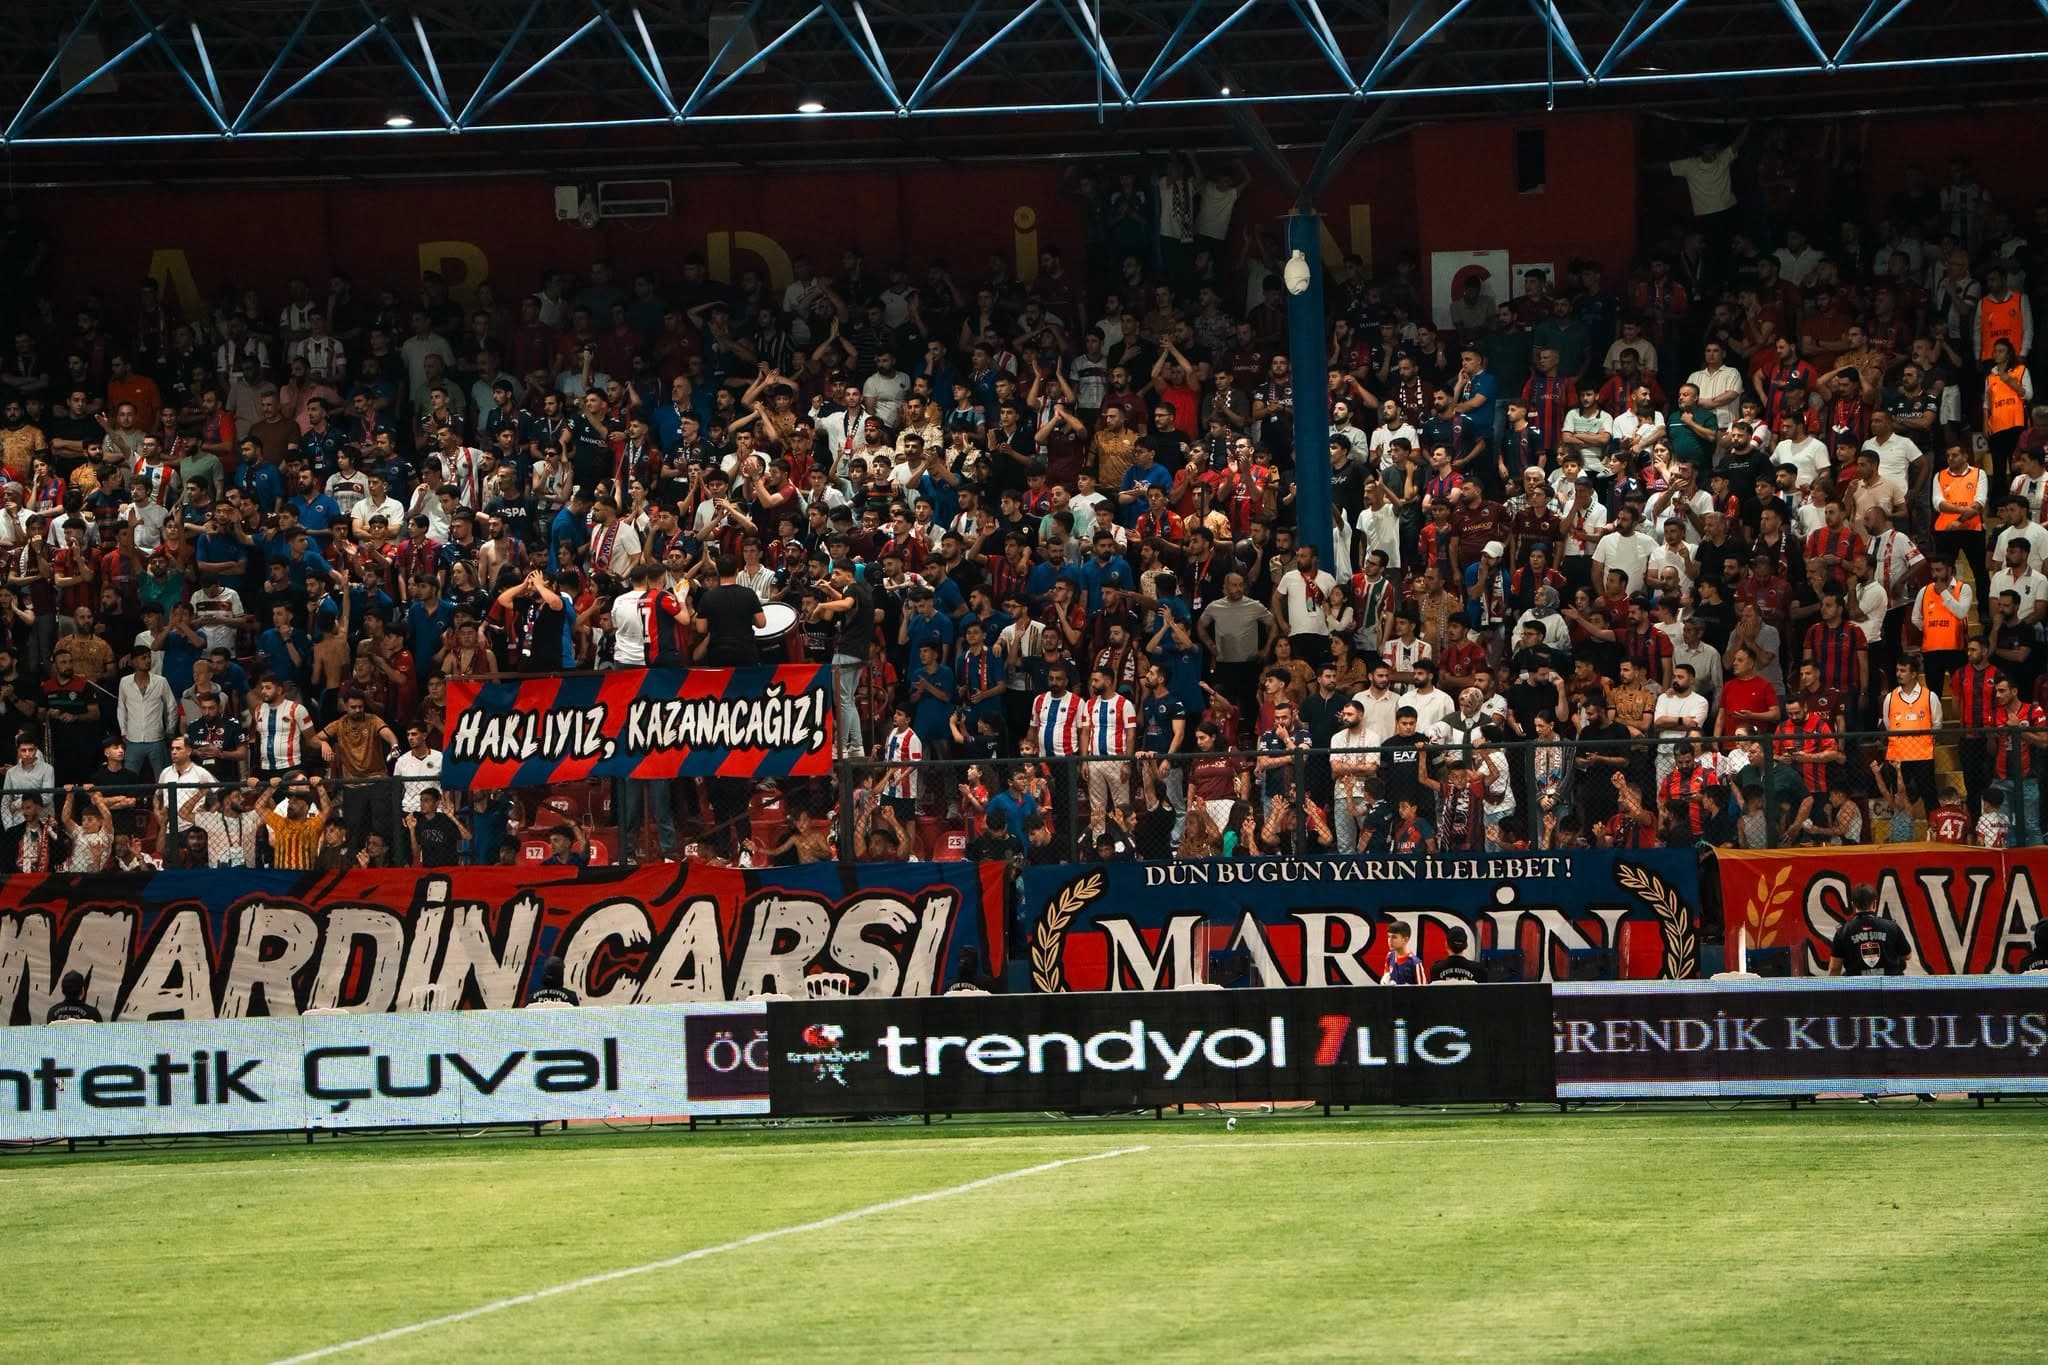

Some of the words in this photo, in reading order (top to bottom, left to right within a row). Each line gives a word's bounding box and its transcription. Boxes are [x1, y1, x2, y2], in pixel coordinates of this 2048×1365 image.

[497, 507, 527, 518] SPA
[454, 705, 616, 759] HAKLIYIZ,
[628, 685, 825, 753] KAZANACAĞIZ!
[1393, 751, 1418, 761] EA7
[1939, 818, 1965, 840] 47
[1144, 858, 1210, 886] DÜN
[1217, 857, 1324, 883] BUGÜN
[1328, 859, 1418, 882] YARIN
[0, 880, 540, 1026] MARDİN
[877, 1016, 1287, 1081] trendyol
[1784, 1012, 2048, 1057] KURULUŞ
[303, 1037, 618, 1114] Çuval
